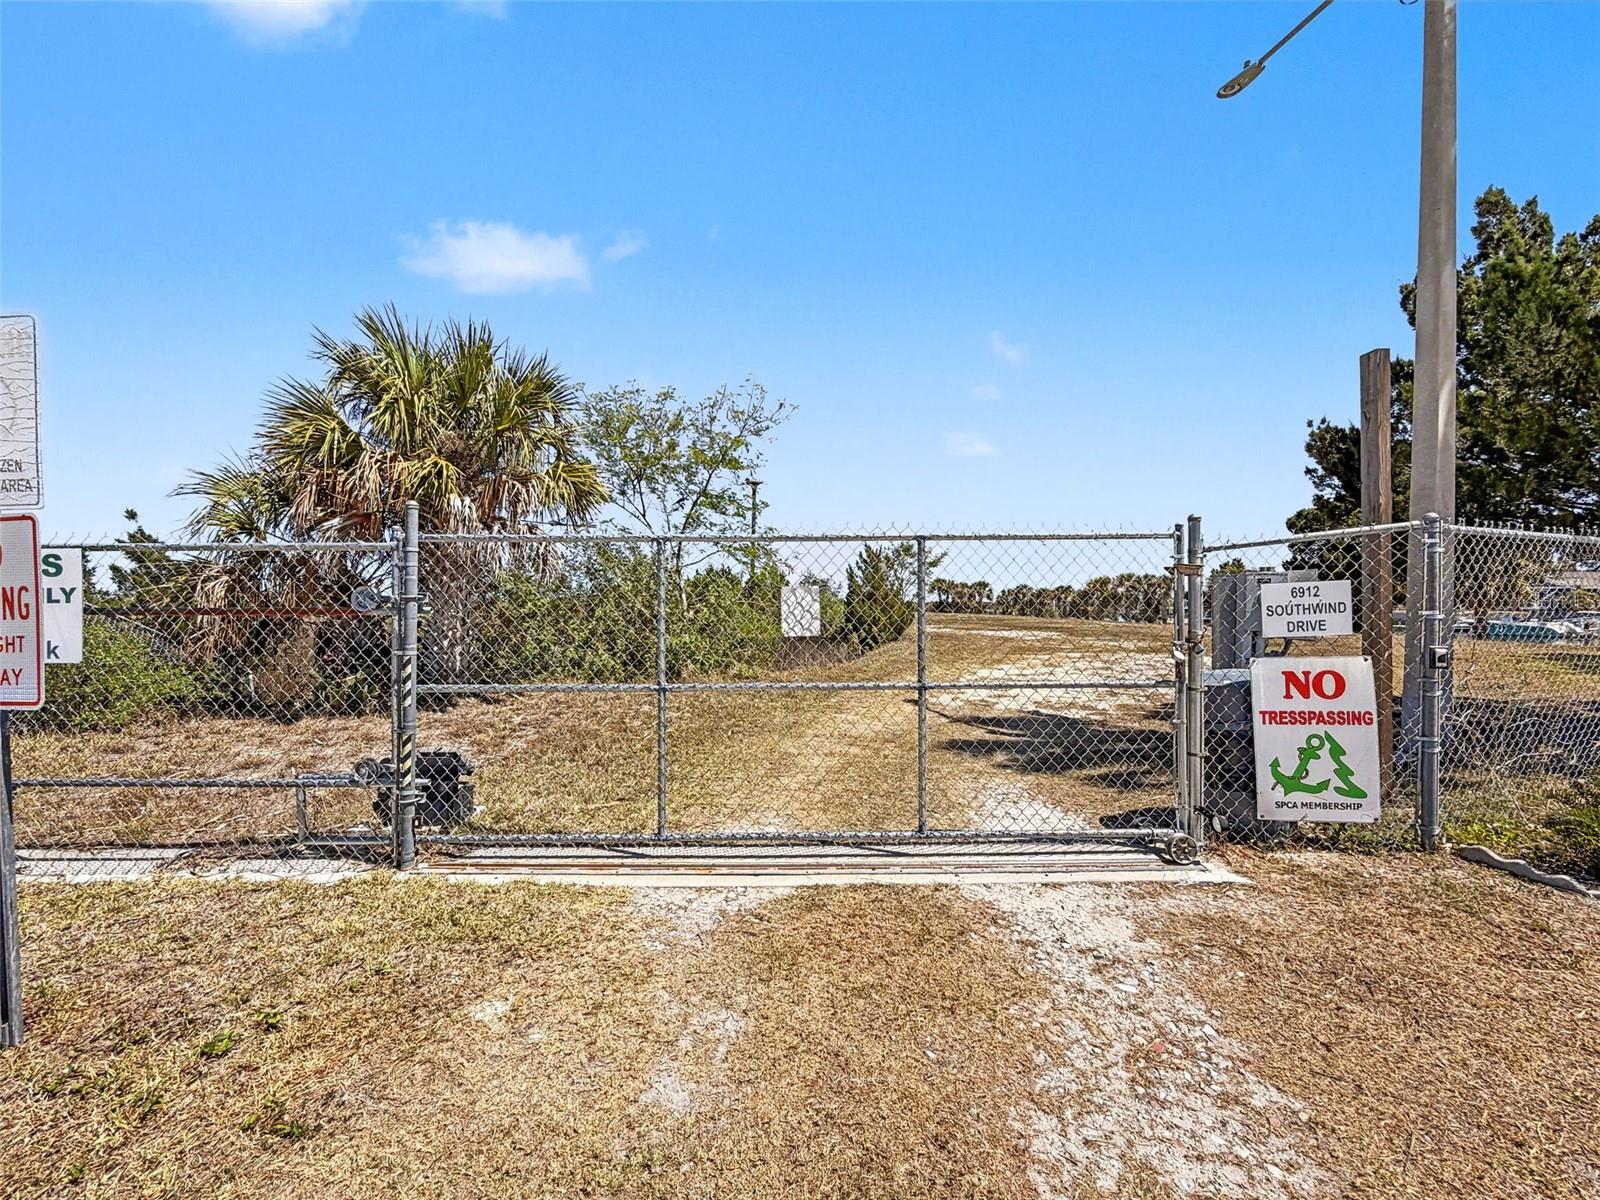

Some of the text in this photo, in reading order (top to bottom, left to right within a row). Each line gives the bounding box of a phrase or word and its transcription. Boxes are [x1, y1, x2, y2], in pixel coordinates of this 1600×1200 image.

[1, 478, 33, 492] AREA
[41, 553, 63, 578] S
[42, 586, 77, 604] LY
[1290, 585, 1320, 598] 6912
[1, 585, 30, 621] NG
[1265, 601, 1347, 617] SOUTHWIND
[1286, 620, 1327, 633] DRIVE
[46, 640, 60, 659] k
[0, 668, 23, 686] AY
[1281, 670, 1346, 699] NO
[1259, 710, 1374, 726] TRESSPASSING
[1274, 801, 1363, 811] SPCA MEMBERSHIP
